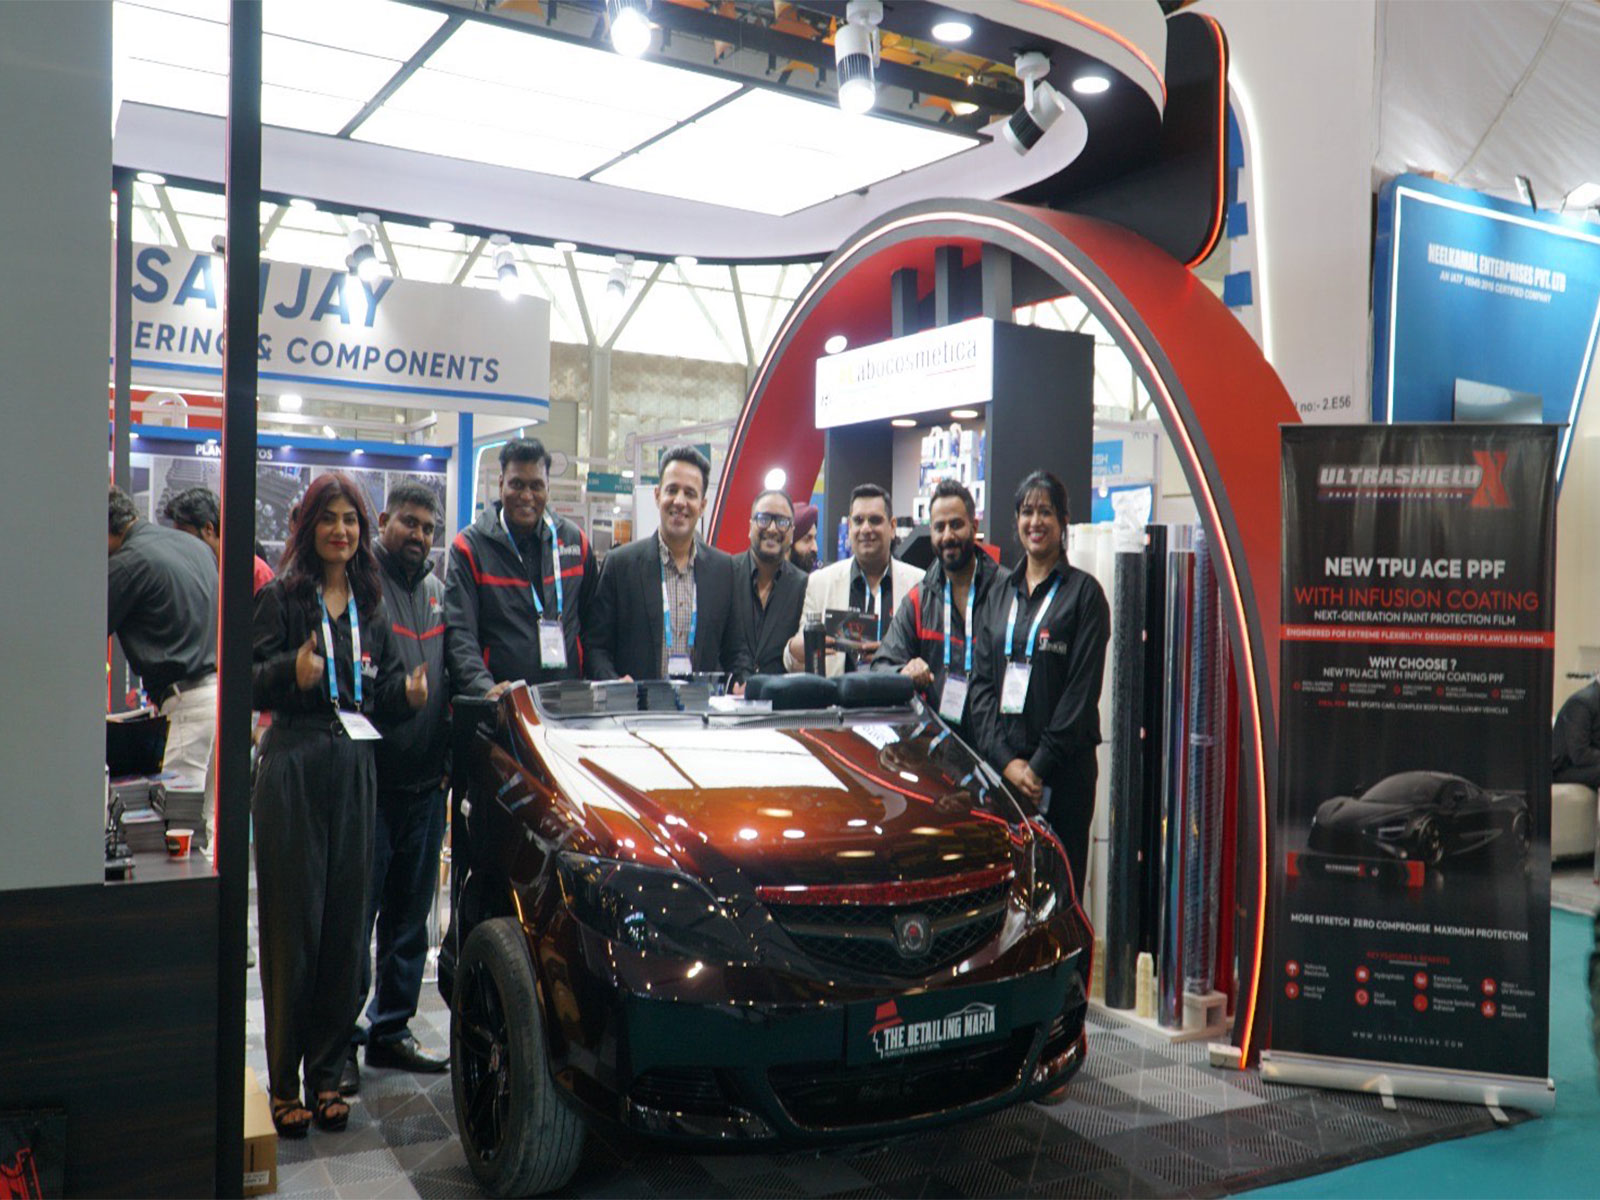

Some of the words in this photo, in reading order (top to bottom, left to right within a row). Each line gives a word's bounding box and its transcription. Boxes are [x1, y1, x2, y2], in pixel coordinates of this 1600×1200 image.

[1428, 242, 1478, 273] NEELKAMAL
[1479, 254, 1534, 286] ENTERPRISES
[131, 247, 394, 328] SAJAY
[1440, 269, 1450, 282] AN
[1495, 282, 1524, 298] CERTIFIED
[1525, 289, 1552, 304] COMPANY
[287, 337, 500, 383] COMPONENTS
[847, 339, 977, 385] abocosmetica
[195, 444, 221, 457] PLAN
[1319, 467, 1482, 486] ULTRASHIELD
[1324, 557, 1373, 577] NEW
[1377, 558, 1417, 579] TPU
[1420, 559, 1462, 579] ACE
[1467, 560, 1506, 580] PPF
[1294, 586, 1343, 606] WITH
[1348, 587, 1441, 609] INFUSION
[1446, 590, 1540, 611] COATING
[1314, 610, 1401, 623] NEXT-GENERATION
[1402, 611, 1429, 623] PAINT
[1430, 612, 1492, 625] PROTECTION
[1493, 615, 1516, 626] FILM
[1286, 628, 1331, 638] ENGINEERED
[1332, 629, 1346, 639] FOR
[1347, 630, 1380, 640] EXTREME
[1424, 632, 1462, 641] DESIGNED
[1463, 633, 1478, 642] FOR
[1480, 633, 1518, 643] FLAWLESS
[1323, 667, 1344, 678] NEW
[1345, 668, 1360, 678] TPU
[1361, 669, 1379, 679] ACE
[1380, 670, 1403, 680] WITH
[1404, 671, 1445, 682] INFUSION
[1446, 672, 1487, 683] COATING
[1488, 673, 1504, 683] PPF
[1369, 656, 1397, 669] WHY
[1398, 657, 1448, 671] CHOOSE
[1450, 659, 1457, 671] ?
[1290, 913, 1314, 924] MORE
[1315, 915, 1350, 926] STRETCH
[1353, 917, 1375, 929] ZERO
[1376, 920, 1430, 934] COMPROMISE
[1433, 925, 1475, 937] MAXIMUM
[1476, 928, 1528, 941] PROTECTION
[884, 1025, 905, 1050] THE
[907, 1016, 961, 1047] DETAILING
[964, 1010, 995, 1037] MAFIA
